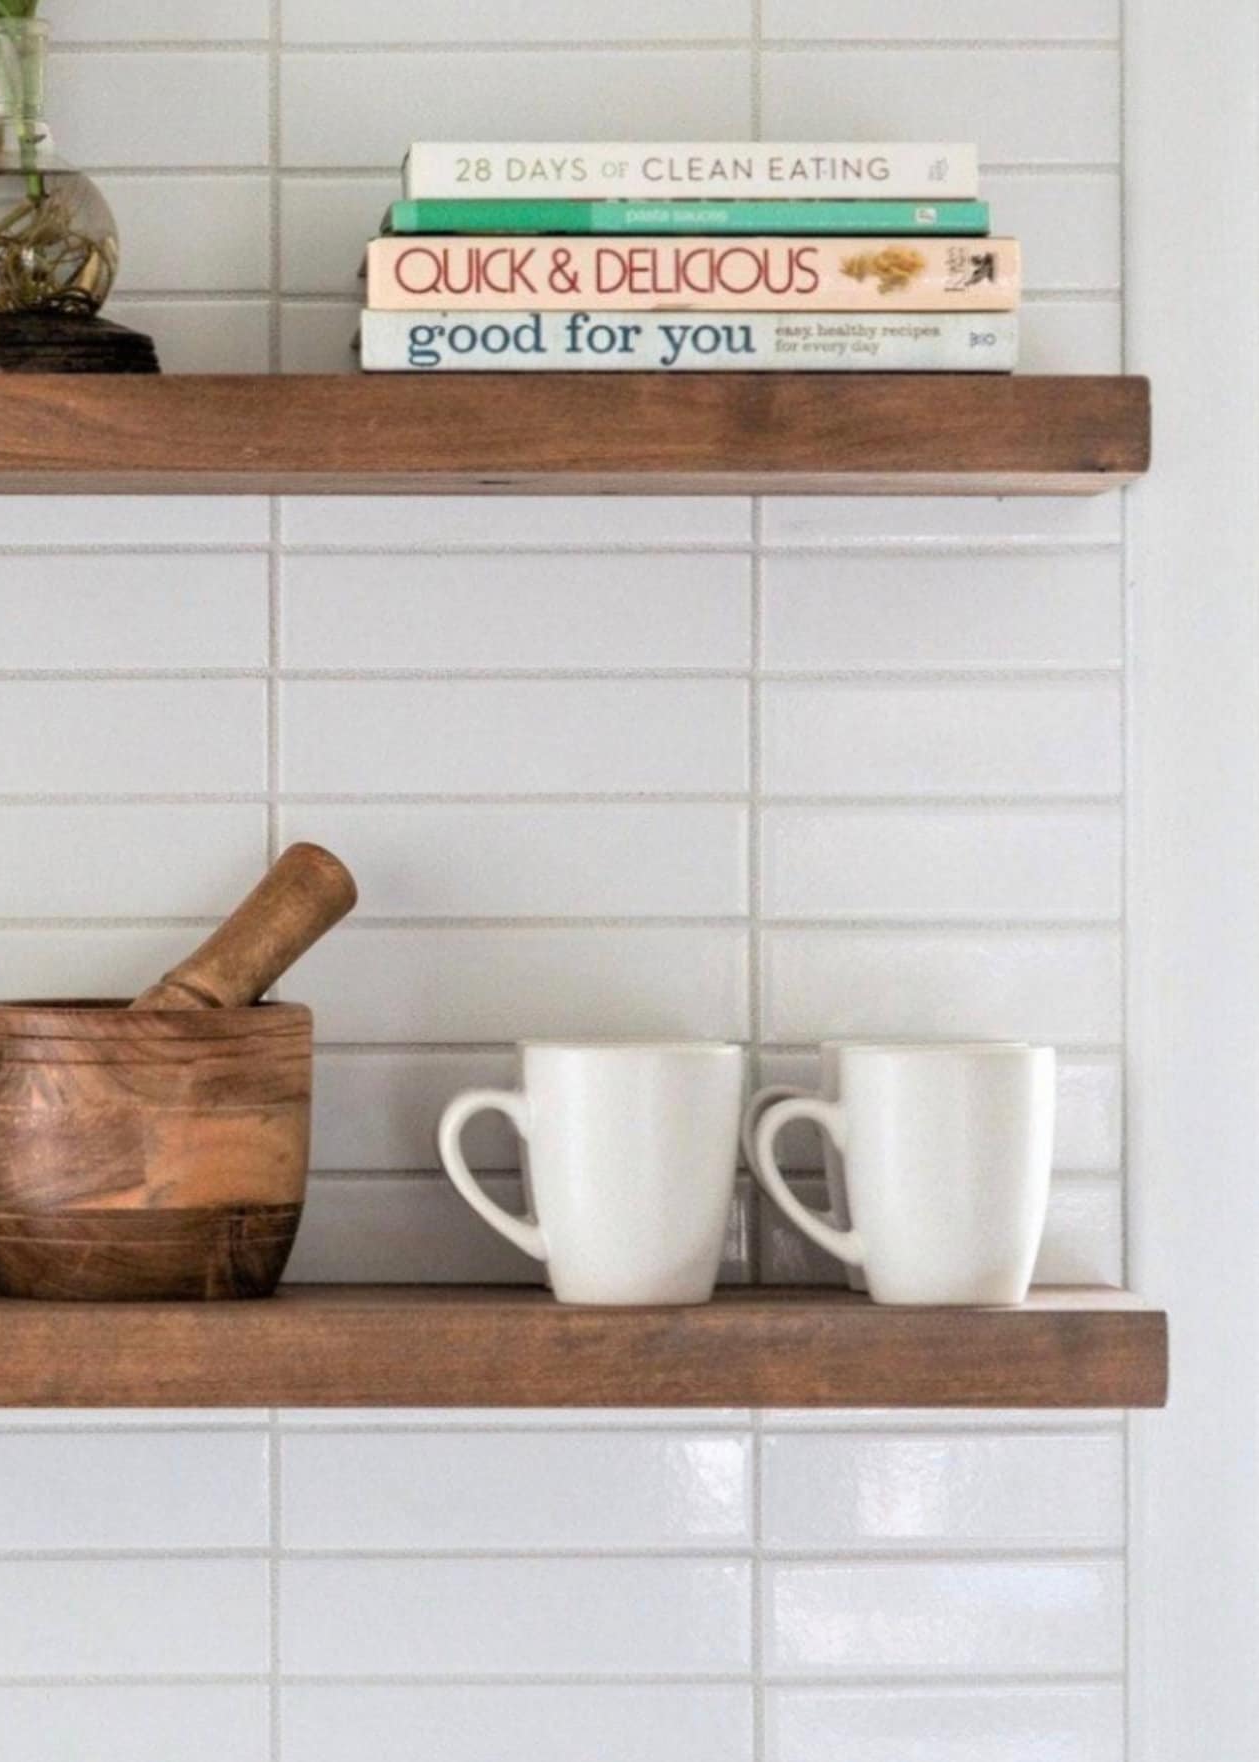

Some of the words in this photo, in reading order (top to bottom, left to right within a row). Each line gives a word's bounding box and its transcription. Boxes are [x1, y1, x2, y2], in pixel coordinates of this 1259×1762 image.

[455, 157, 491, 182] 28
[506, 157, 588, 182] DAYS
[601, 161, 629, 179] OF
[642, 157, 753, 182] CLEAN
[768, 157, 891, 181] EATING
[395, 247, 538, 295] QUICK
[548, 247, 581, 294] &
[596, 247, 819, 295] DELICIOUS
[407, 311, 547, 367] good
[565, 310, 642, 354] for
[658, 323, 756, 367] you
[817, 323, 878, 338] healthy
[882, 324, 941, 341] recipes
[775, 339, 798, 352] for
[802, 342, 847, 356] every
[851, 340, 880, 356] day
